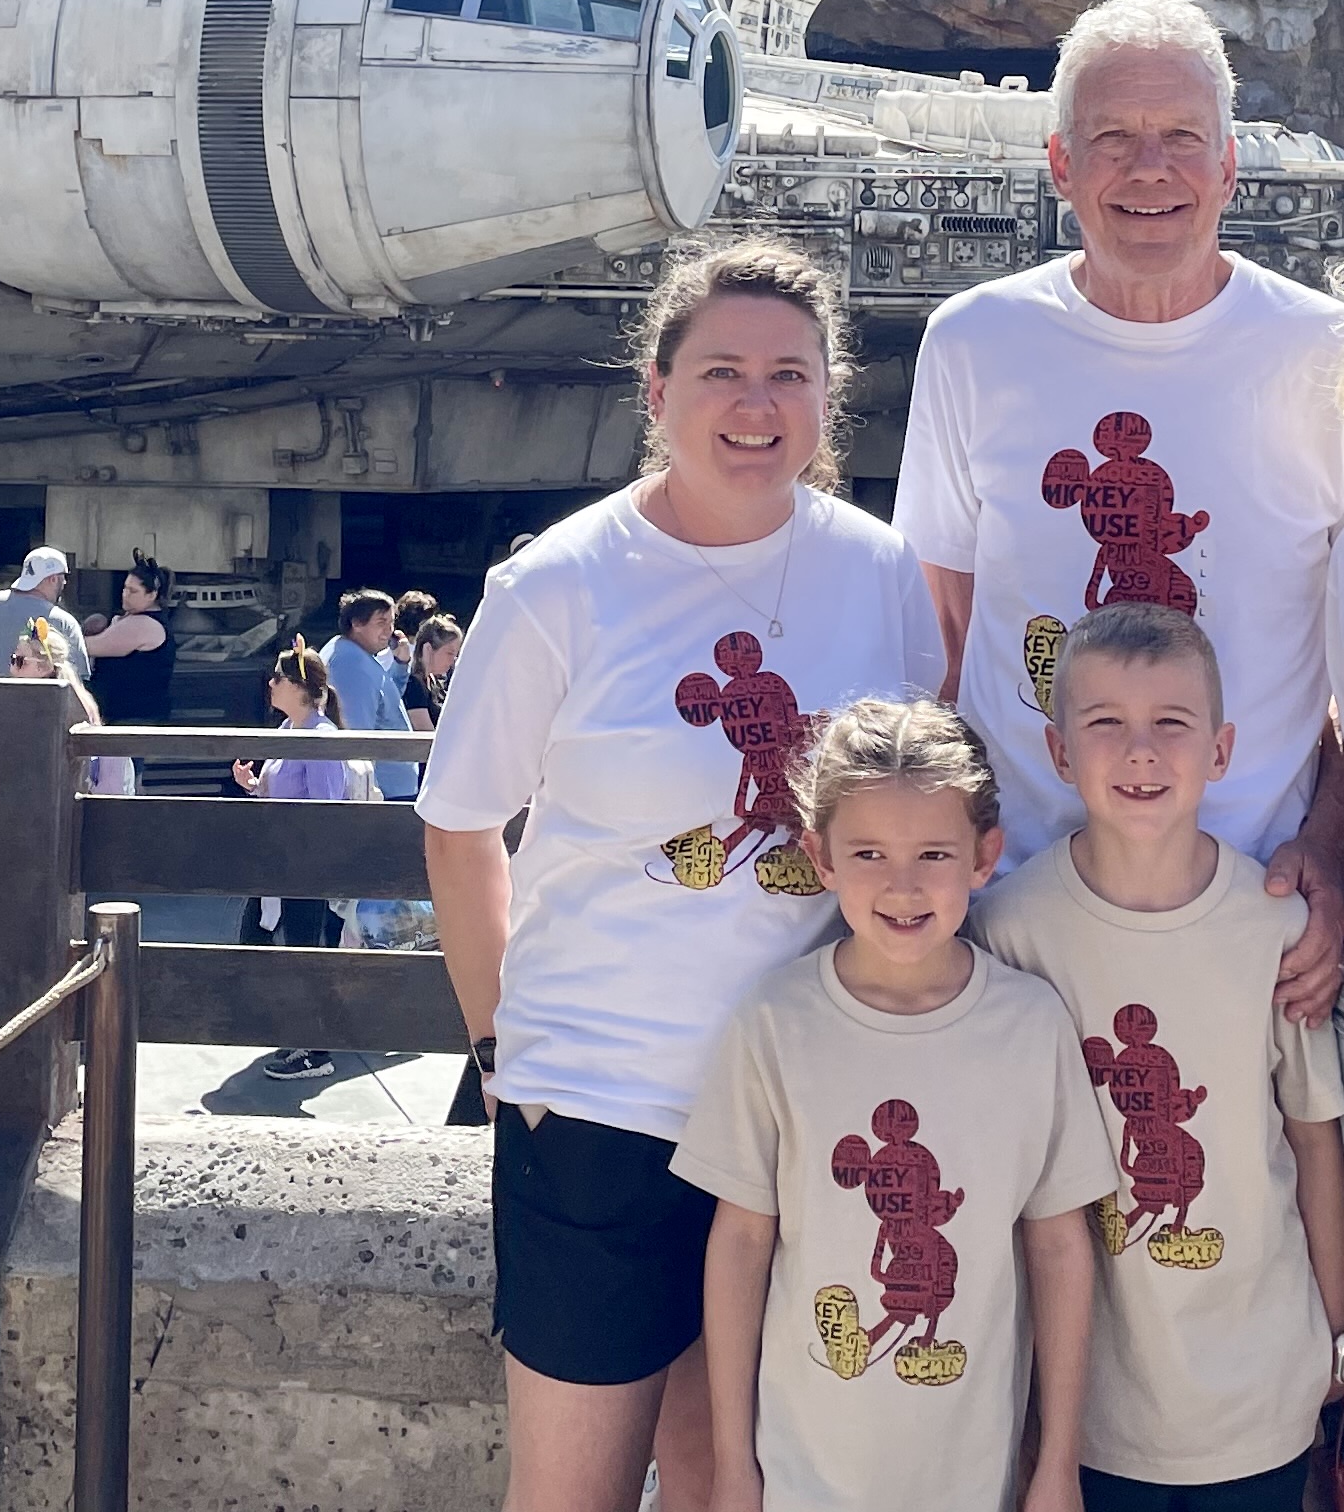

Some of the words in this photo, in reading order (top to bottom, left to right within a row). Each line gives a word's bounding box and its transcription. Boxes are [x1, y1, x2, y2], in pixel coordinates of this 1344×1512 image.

[1044, 483, 1137, 508] MICKEY
[1200, 549, 1207, 558] L
[1200, 569, 1207, 578] L
[1199, 589, 1206, 597] L
[1199, 608, 1205, 617] L
[678, 695, 764, 723] MICKEY
[1090, 1067, 1152, 1087] ICKEY
[833, 1166, 910, 1188] MICKEY
